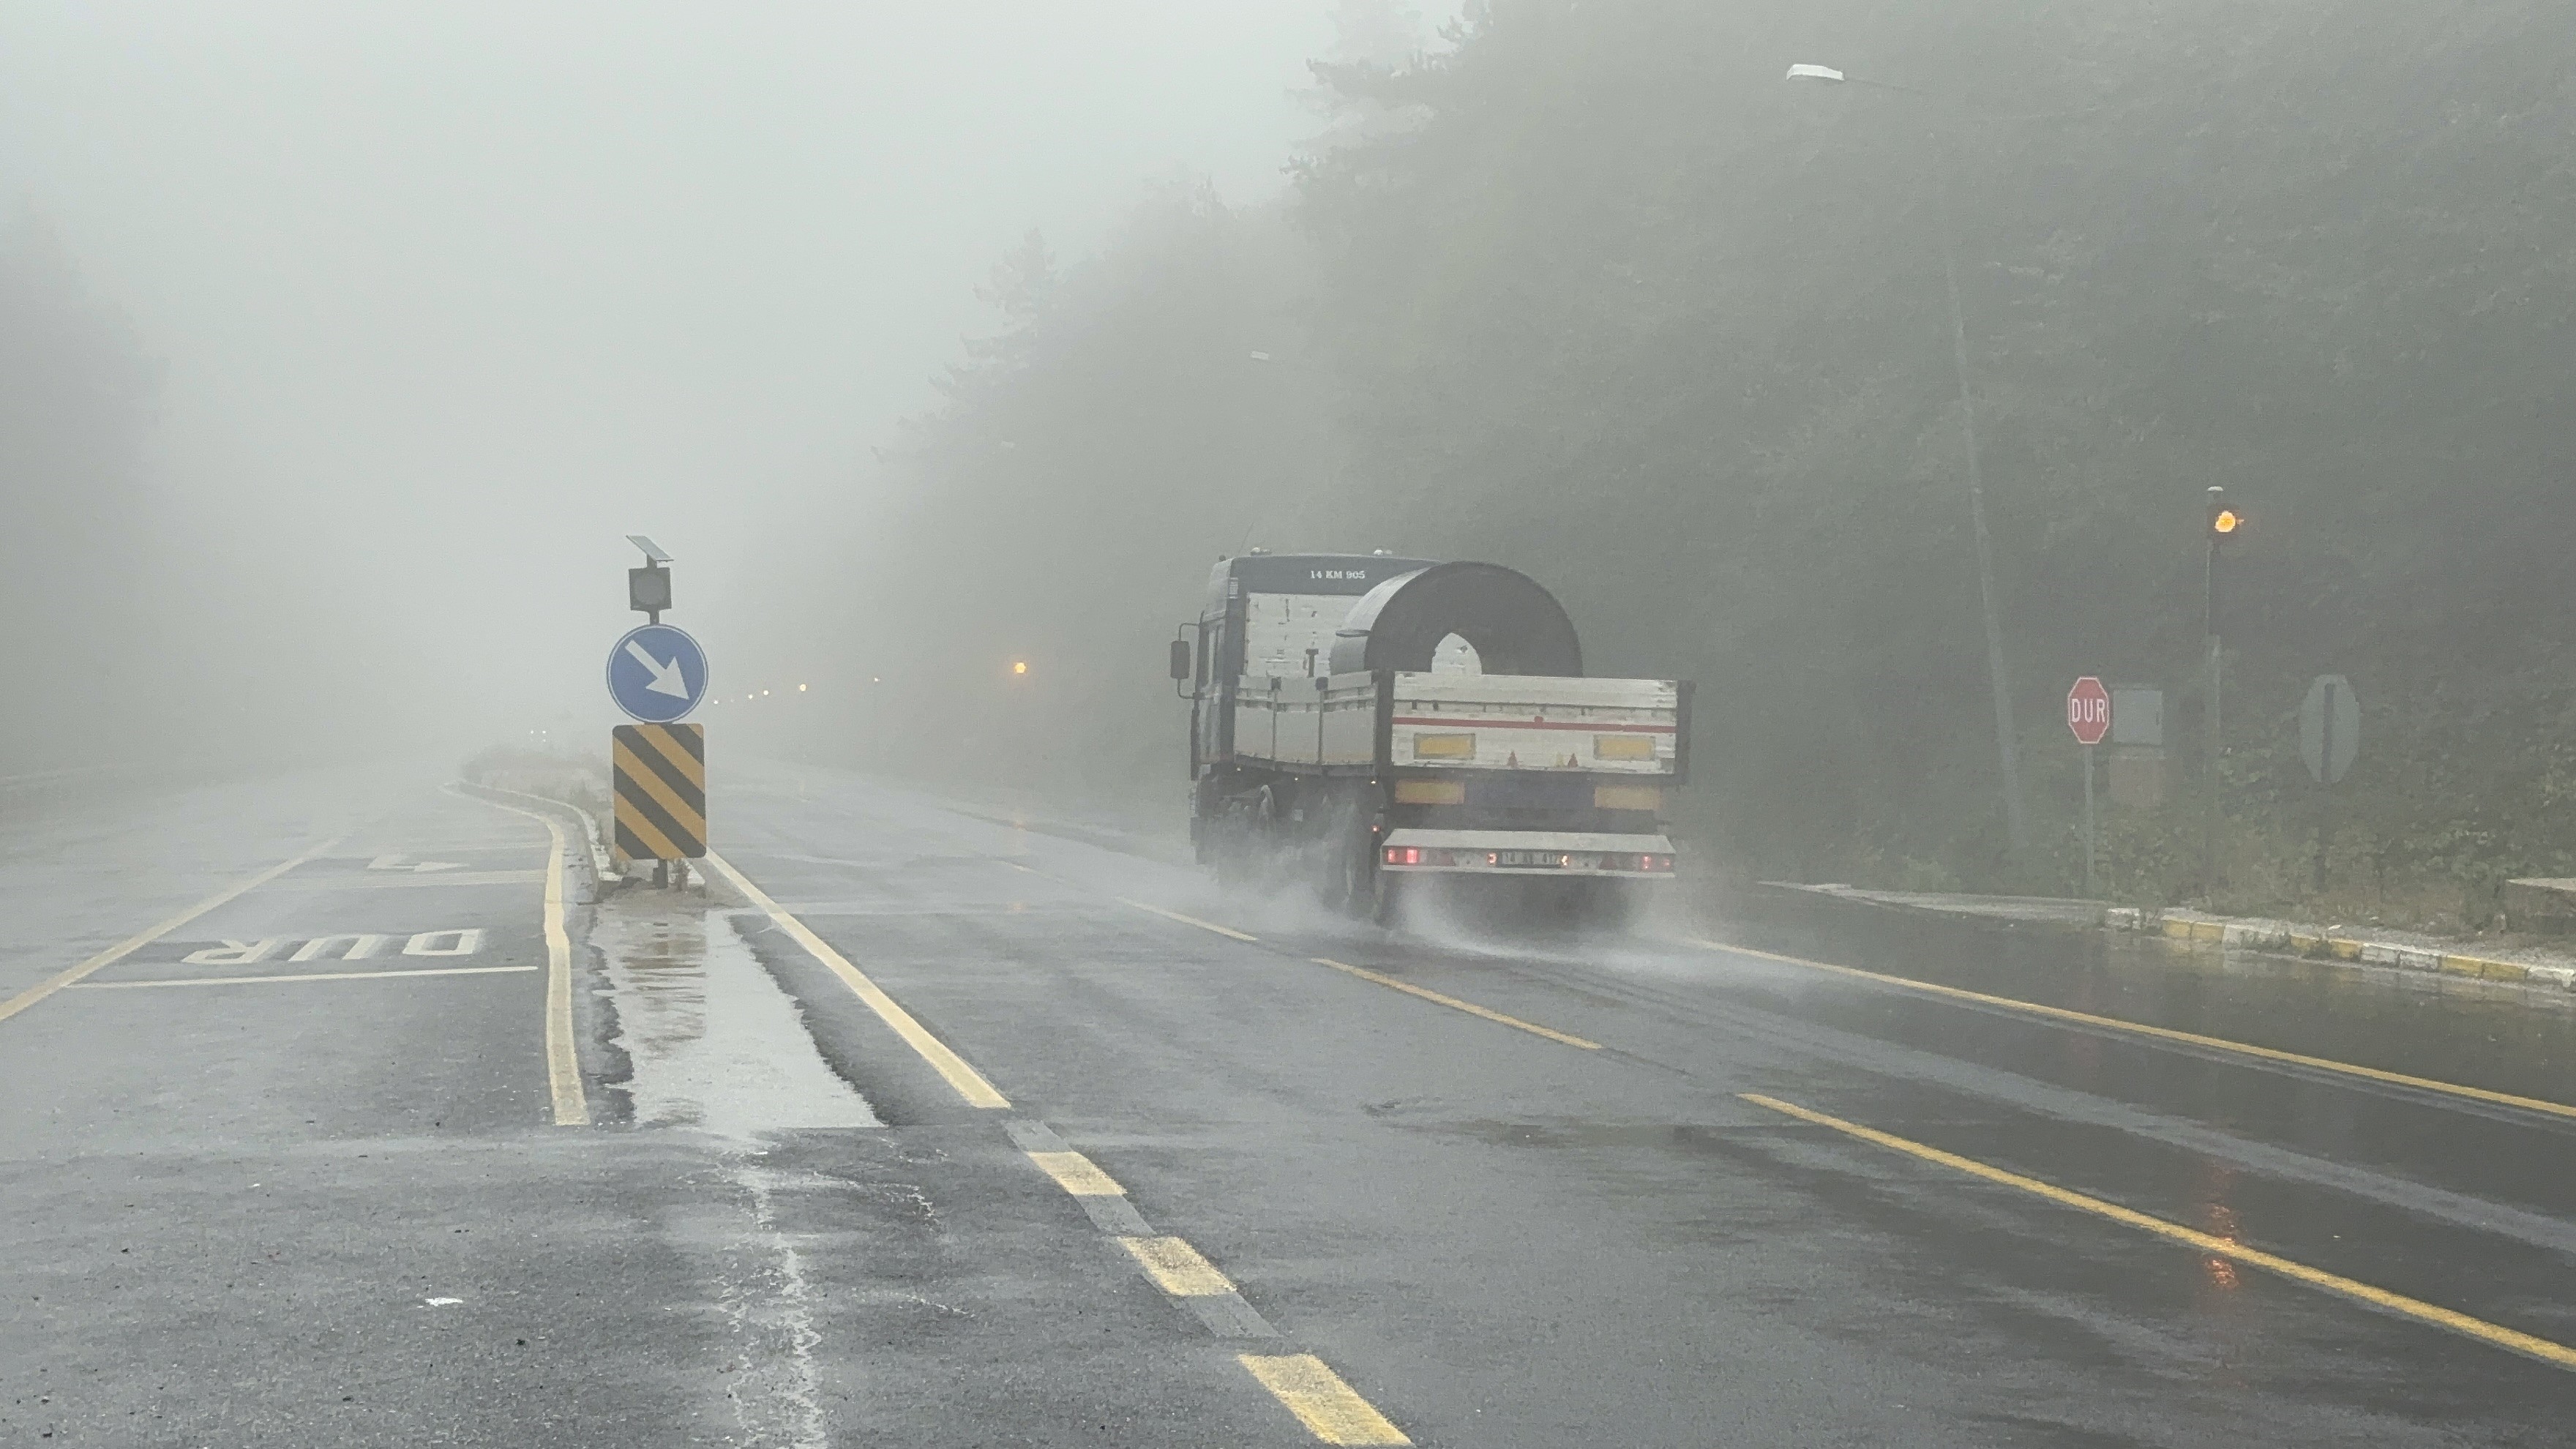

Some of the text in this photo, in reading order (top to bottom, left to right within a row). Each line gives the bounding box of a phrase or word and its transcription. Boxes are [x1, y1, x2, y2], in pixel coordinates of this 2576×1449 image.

[1311, 570, 1322, 579] 14
[1325, 570, 1342, 579] KM
[2072, 698, 2105, 723] DUR
[181, 928, 482, 965] DUR
